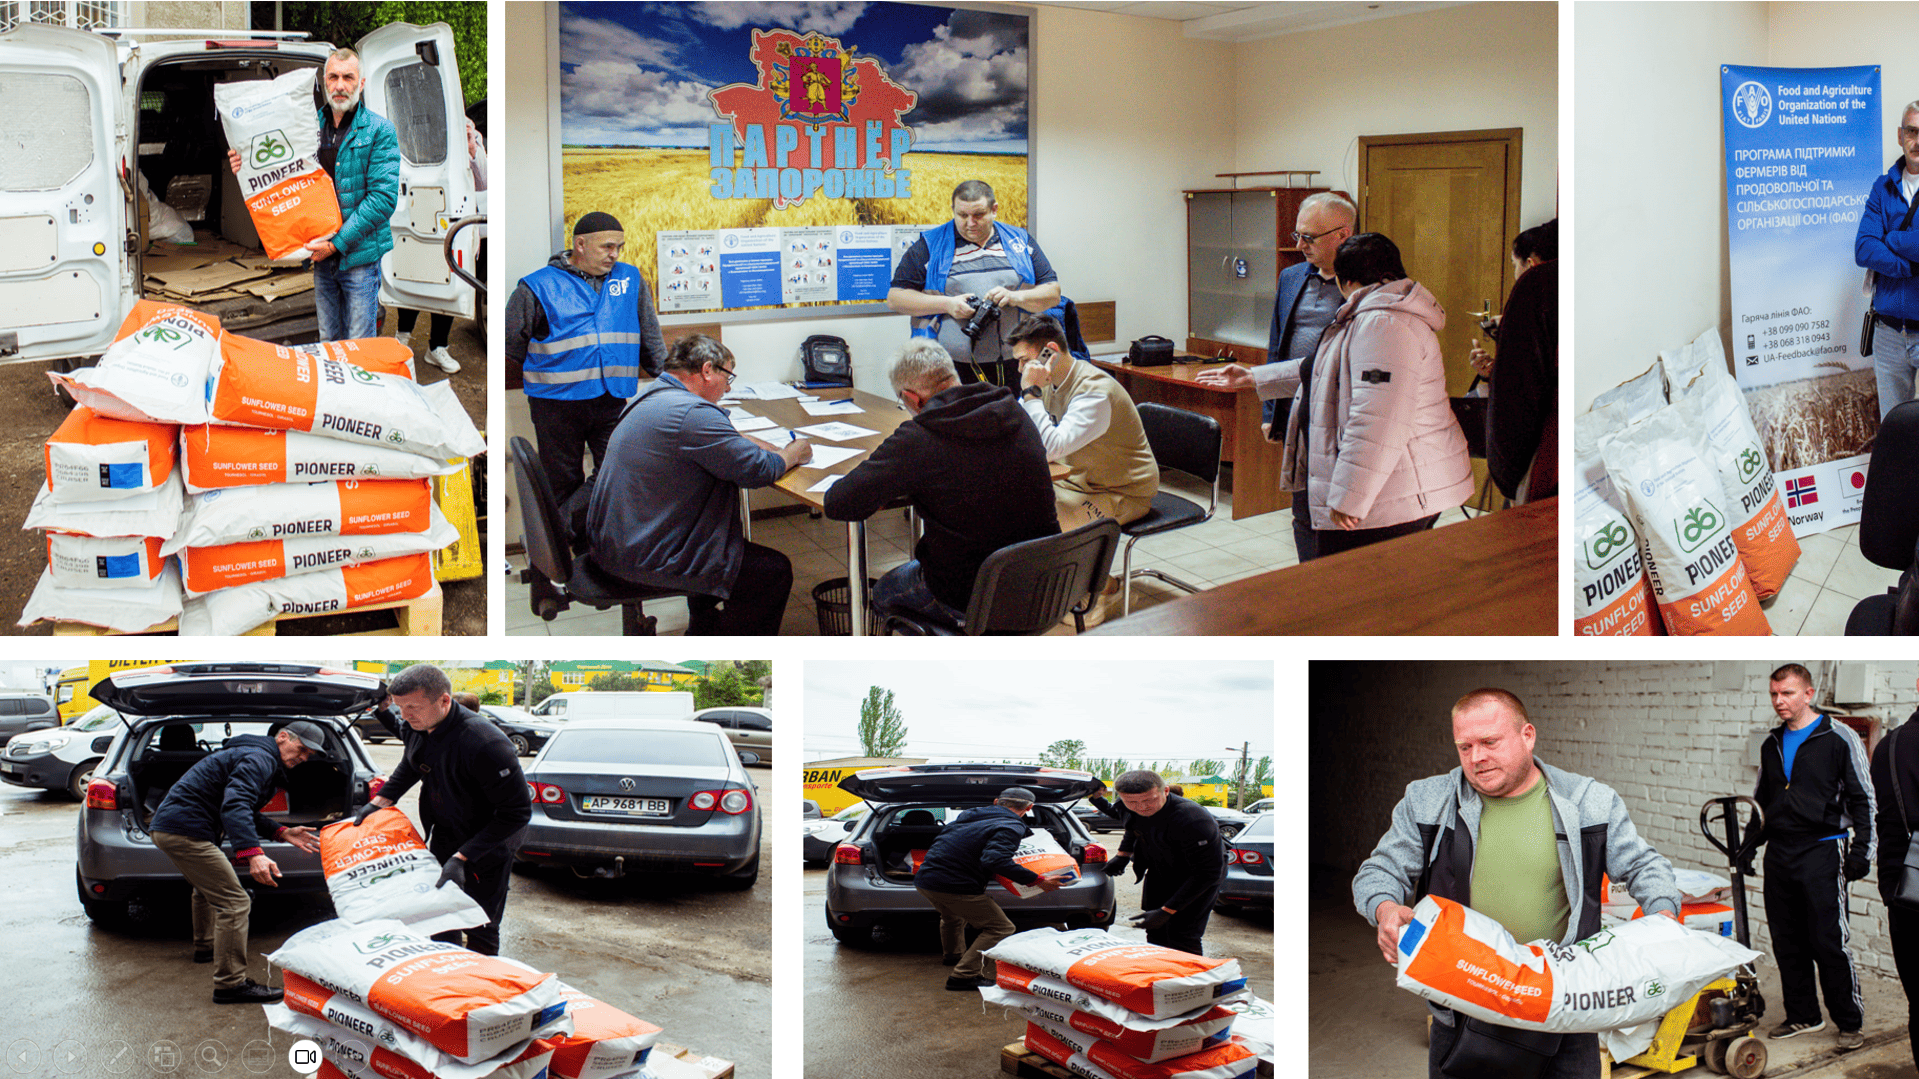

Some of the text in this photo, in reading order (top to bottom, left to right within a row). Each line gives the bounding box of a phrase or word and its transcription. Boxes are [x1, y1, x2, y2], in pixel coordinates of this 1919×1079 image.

[1778, 84, 1872, 98] Food and Agriculture
[1778, 98, 1866, 113] Organization of the
[1779, 113, 1847, 125] United Nations
[709, 120, 911, 169] ПАРТНЁР
[1735, 146, 1855, 161] ПРОГРАМА ПІДТРИМКИ
[1735, 164, 1807, 179] ФЕРМЕРІВ ВІД
[710, 168, 912, 199] ЗАПОРОЖЬЕ
[1736, 180, 1834, 196] ПРОДОВОЛЬЧОЇ ТА
[271, 196, 301, 217] SEED
[1736, 194, 1869, 213] СІЛЬСЬКОГОСПОДАРСЬКО
[1737, 211, 1859, 231] ОРГАНІЗАЦІЇ ООН (ФАО)
[1741, 306, 1813, 325] Гаряча лінія ФАО:
[164, 317, 205, 339] PION
[1762, 320, 1830, 337] +38 099 090 7582
[1763, 332, 1831, 350] +38 068 318 0943
[1764, 343, 1847, 363] UA-Feedback@fao.org
[241, 396, 307, 417] SUNFLOWER SEED
[322, 413, 382, 440] PIONEER
[213, 462, 278, 471] SUNFLOWER SEED
[294, 462, 355, 476] PIONEER
[349, 511, 410, 525] SUNFLOWER SEED
[1788, 510, 1824, 526] Norway
[272, 519, 332, 537] PIONEER
[212, 559, 277, 573] SUNFLOWER SEED
[293, 549, 351, 569] PIONEER
[354, 579, 412, 602] SUNFLOWER SEED
[282, 599, 339, 614] PIONEER
[1722, 589, 1748, 622] SEED
[803, 770, 842, 783] RBAN
[591, 798, 666, 811] AP 9681 BB
[353, 833, 387, 849] SEED
[1032, 984, 1072, 1004] PIONEER
[1514, 985, 1542, 997] SEED
[1562, 986, 1637, 1012] PIONEER
[328, 1008, 374, 1037] PIONEER
[412, 1020, 431, 1034] SEED
